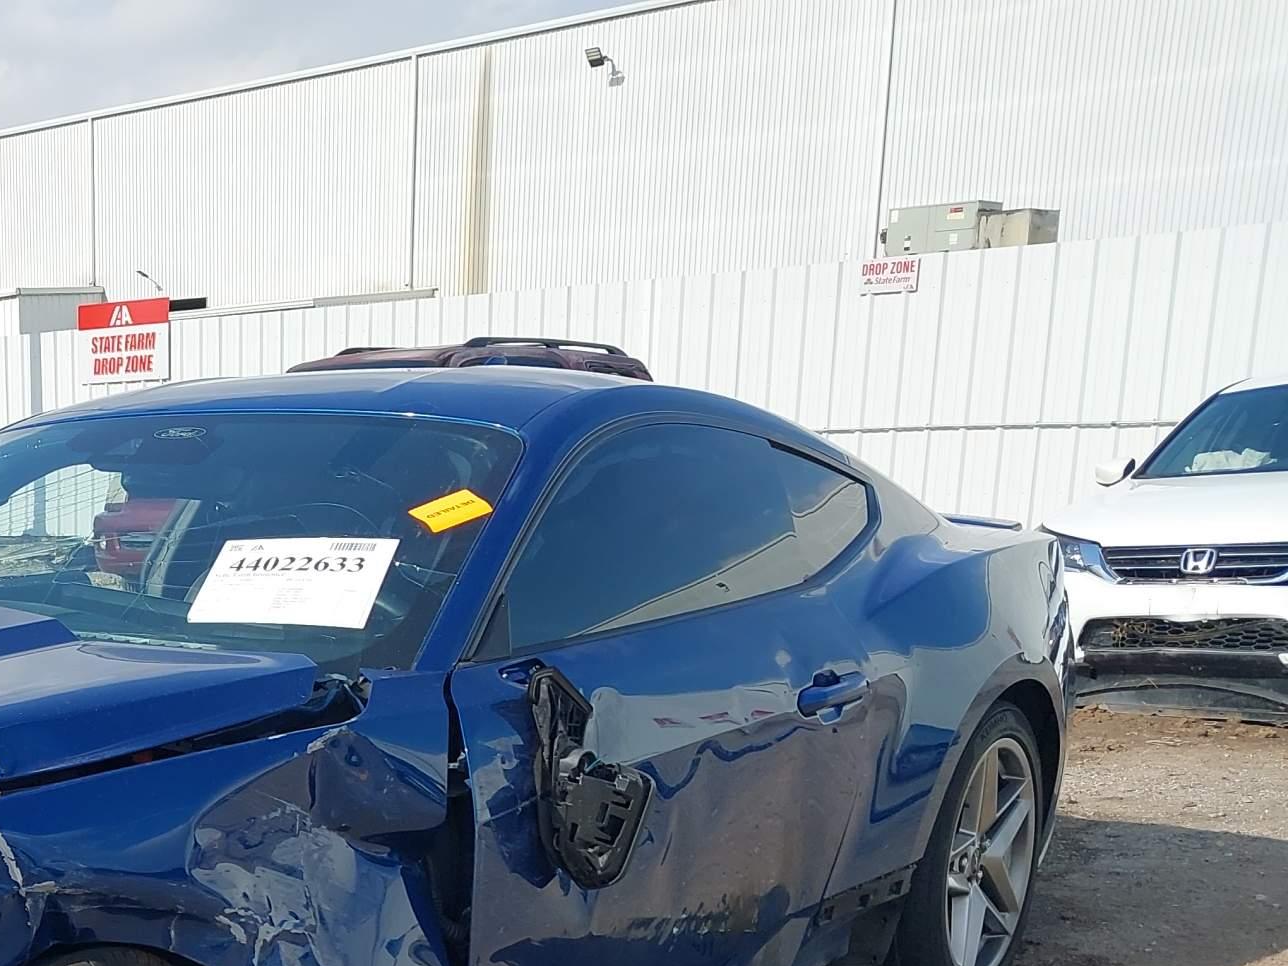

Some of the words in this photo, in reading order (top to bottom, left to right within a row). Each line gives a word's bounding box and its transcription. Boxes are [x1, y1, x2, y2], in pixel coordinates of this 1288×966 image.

[862, 262, 888, 276] DROP
[890, 260, 916, 274] ZONE
[91, 335, 123, 354] STATE
[124, 332, 156, 351] FARM
[94, 357, 124, 375] DROP
[124, 355, 154, 373] ZONE
[229, 556, 366, 573] 44022633
